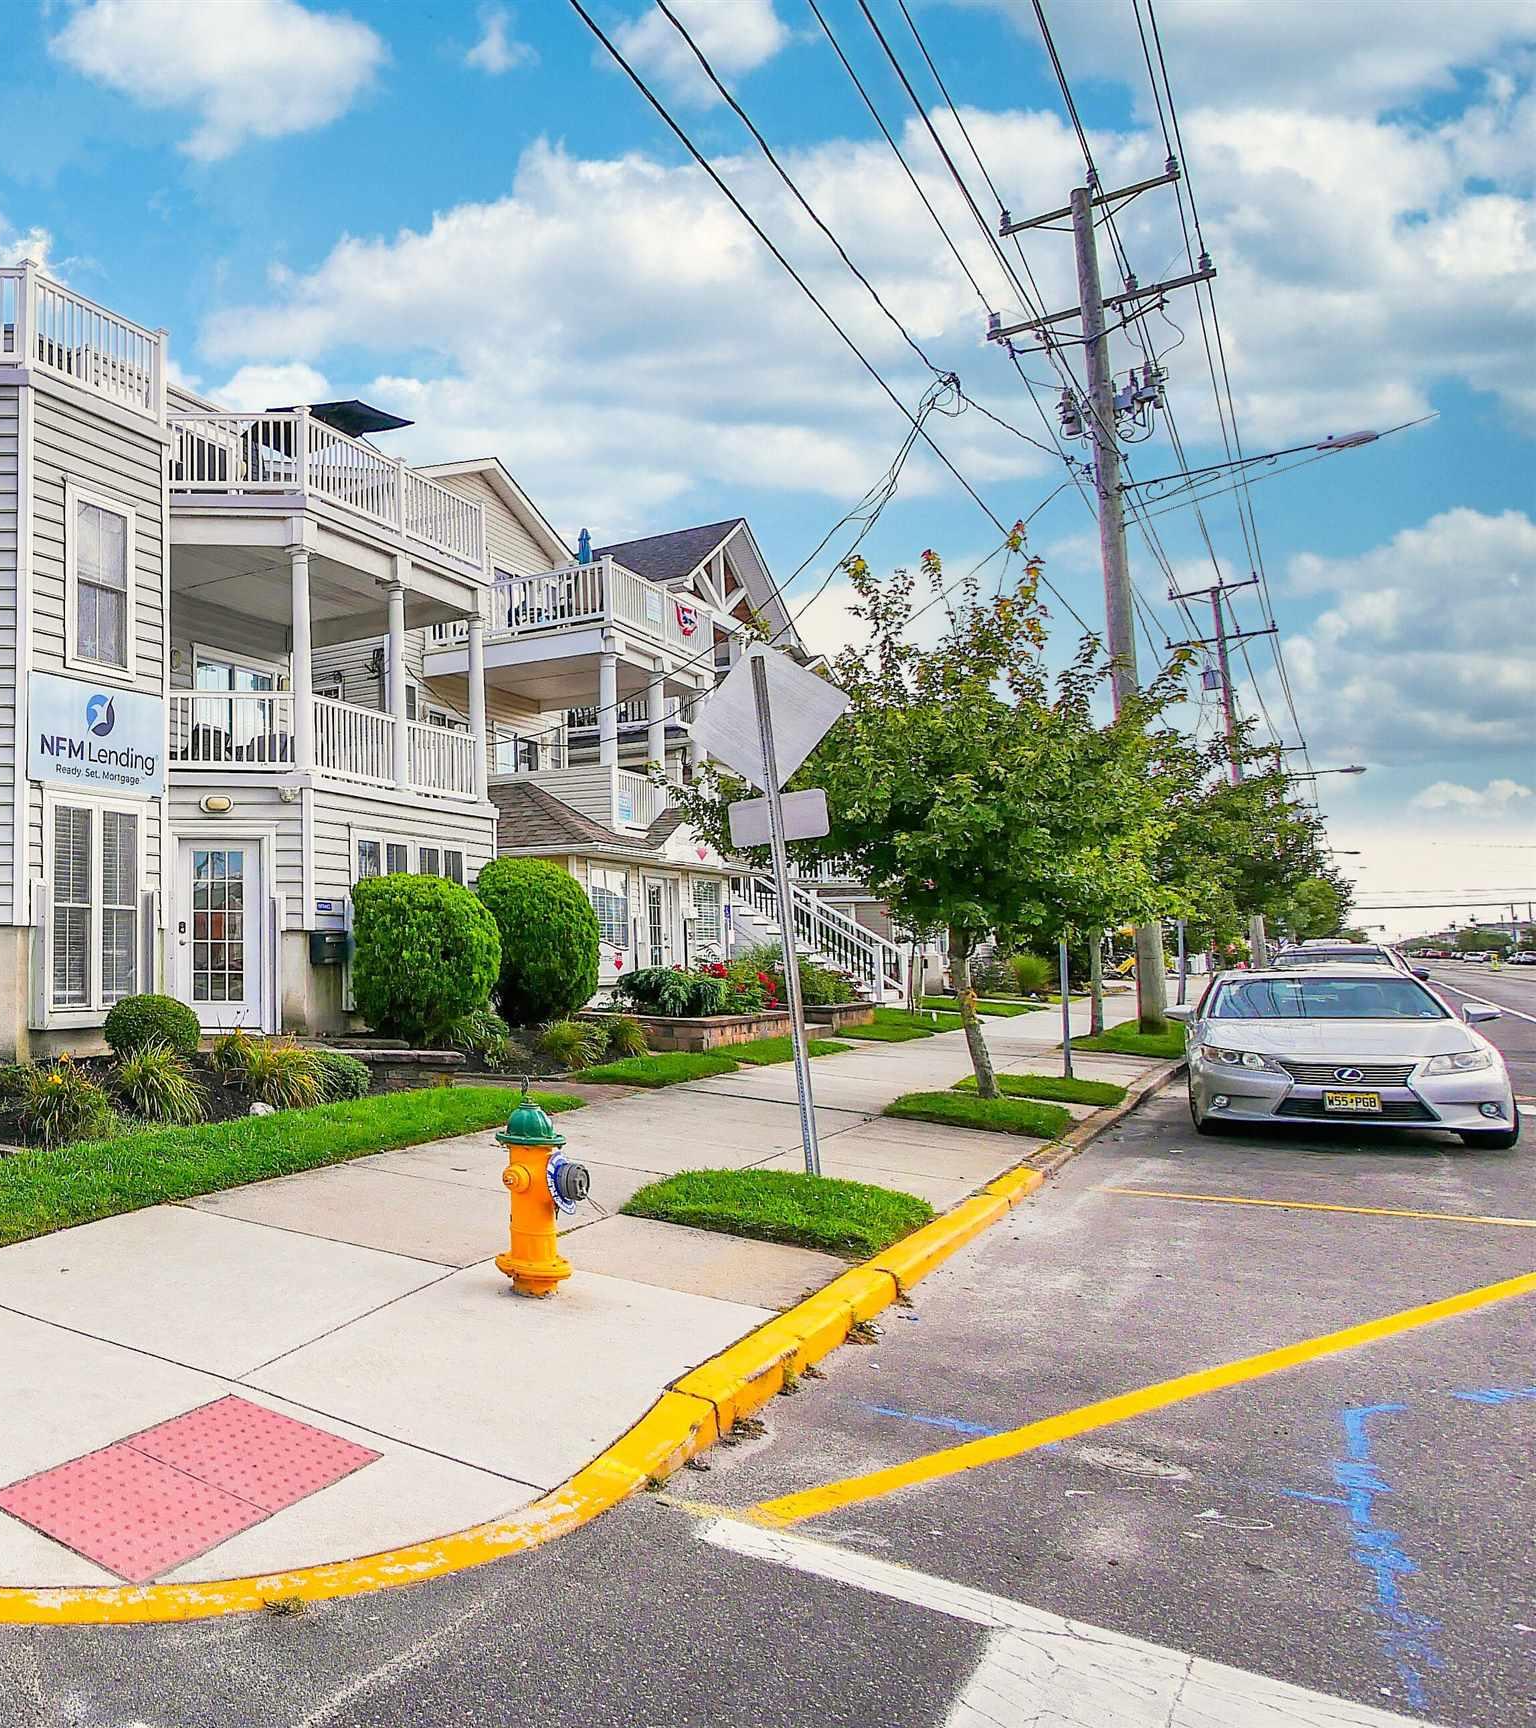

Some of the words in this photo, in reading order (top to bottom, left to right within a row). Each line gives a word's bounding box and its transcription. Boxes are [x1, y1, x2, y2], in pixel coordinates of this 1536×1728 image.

[40, 734, 84, 761] NFM
[88, 741, 155, 776] Lending
[55, 763, 83, 778] Ready.
[85, 768, 100, 779] Set.
